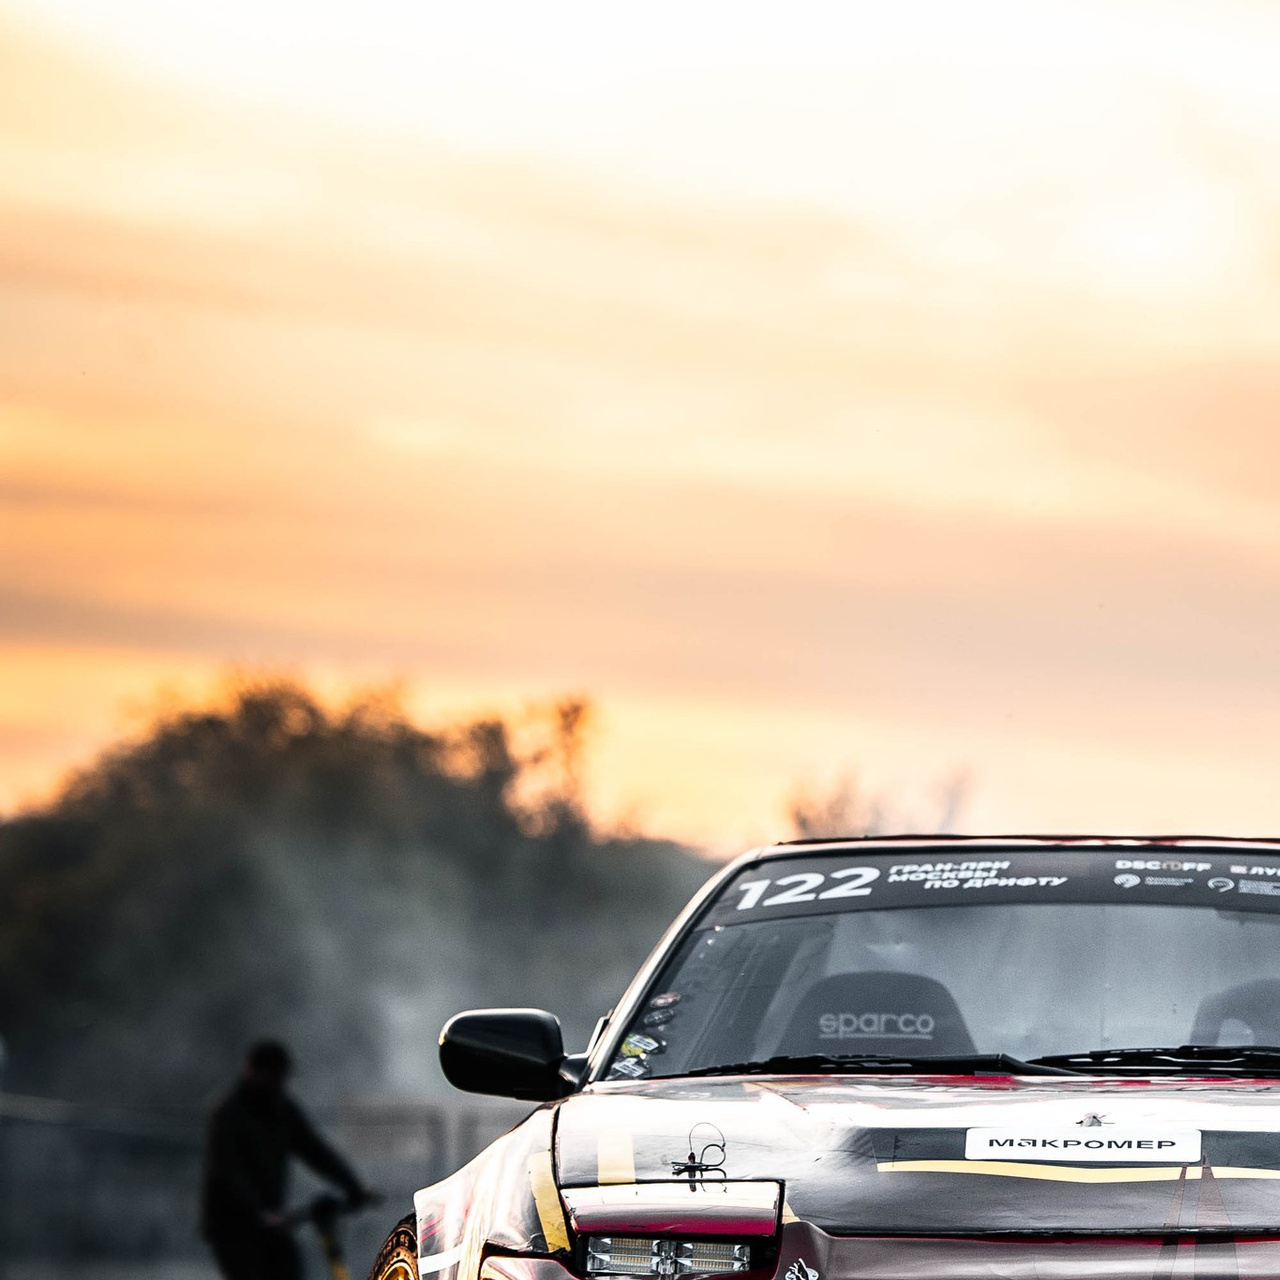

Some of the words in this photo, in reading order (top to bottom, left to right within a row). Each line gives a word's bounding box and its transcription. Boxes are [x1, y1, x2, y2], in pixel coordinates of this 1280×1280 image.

[889, 861, 1010, 874] ГРАН-ПРИ
[887, 870, 998, 883] МОСКВЫ
[923, 879, 960, 889] ПО
[962, 876, 1069, 889] ДРИФТУ
[737, 867, 881, 910] 122
[818, 1012, 935, 1039] sparco
